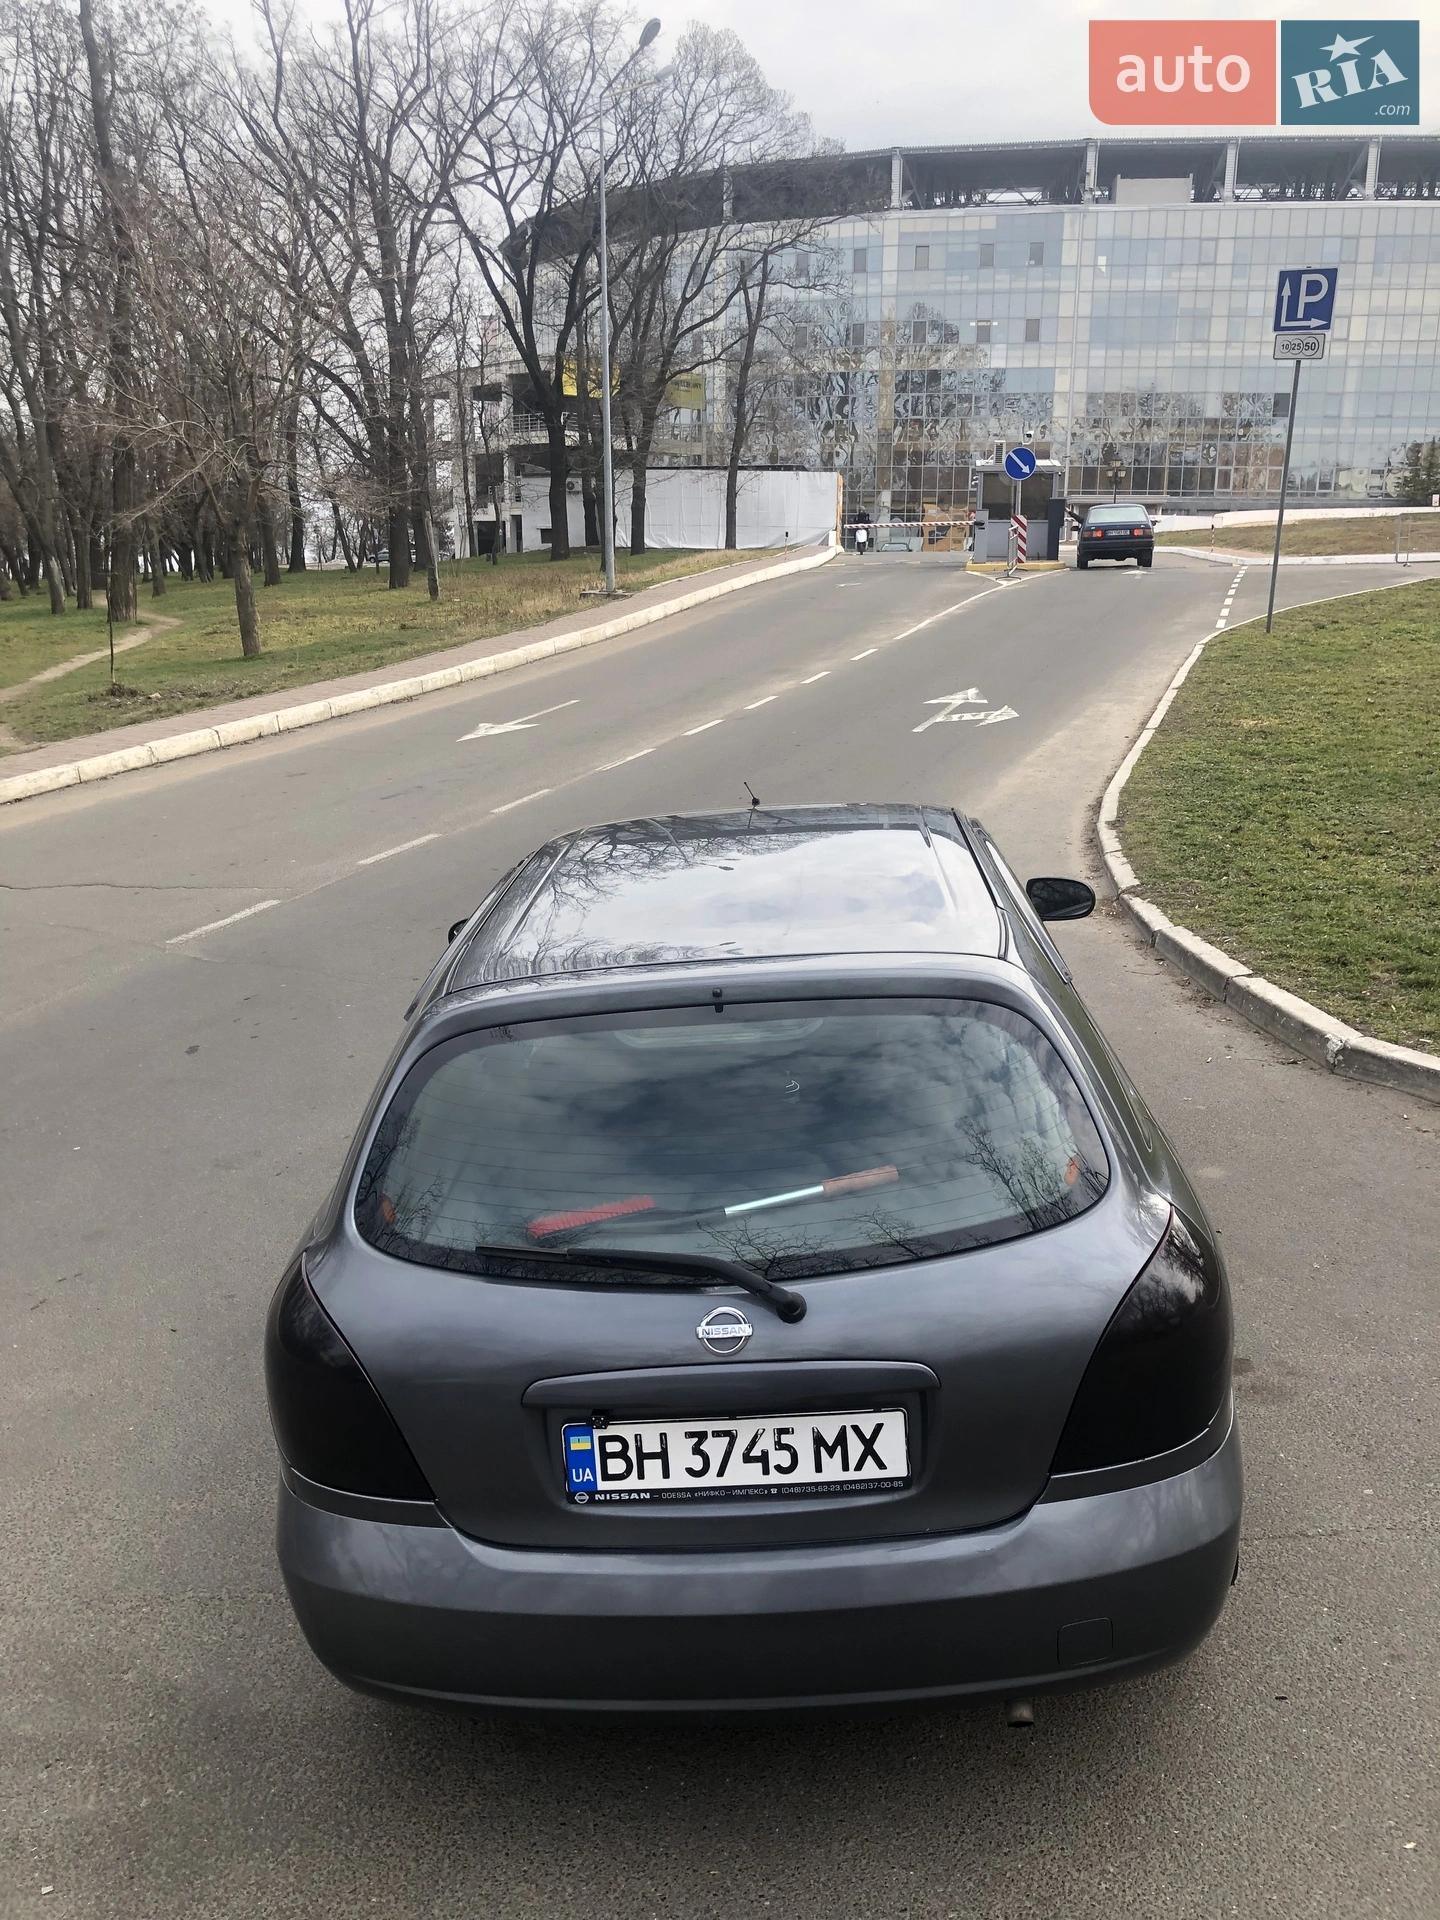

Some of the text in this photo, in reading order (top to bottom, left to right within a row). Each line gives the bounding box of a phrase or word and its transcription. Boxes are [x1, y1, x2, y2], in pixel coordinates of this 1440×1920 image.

[1297, 273, 1329, 319] P
[701, 1326, 747, 1336] NISSAN
[598, 1422, 888, 1482] BH 3745 MX
[572, 1468, 594, 1483] UA
[594, 1492, 651, 1501] NISSAN
